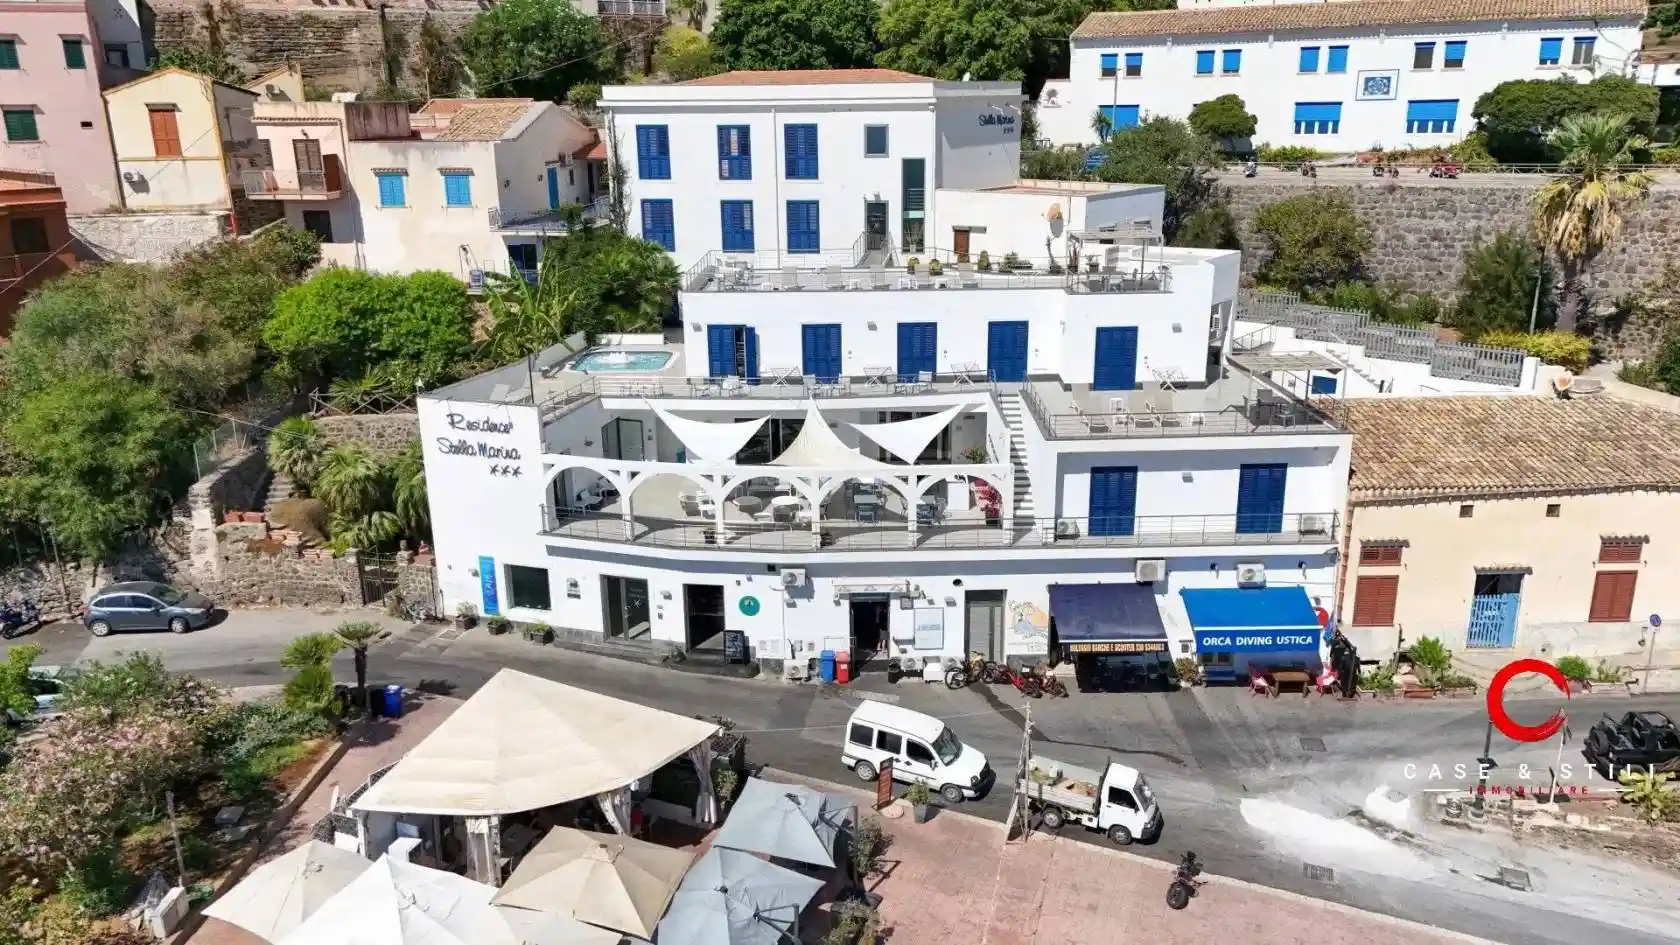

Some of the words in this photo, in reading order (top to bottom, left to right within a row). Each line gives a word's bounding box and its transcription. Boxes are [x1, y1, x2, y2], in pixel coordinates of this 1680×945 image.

[436, 437, 477, 456] Stella
[477, 441, 521, 460] Marina
[1202, 637, 1232, 646] ORCA
[1236, 636, 1272, 646] DIVING
[1276, 636, 1313, 645] USTICA
